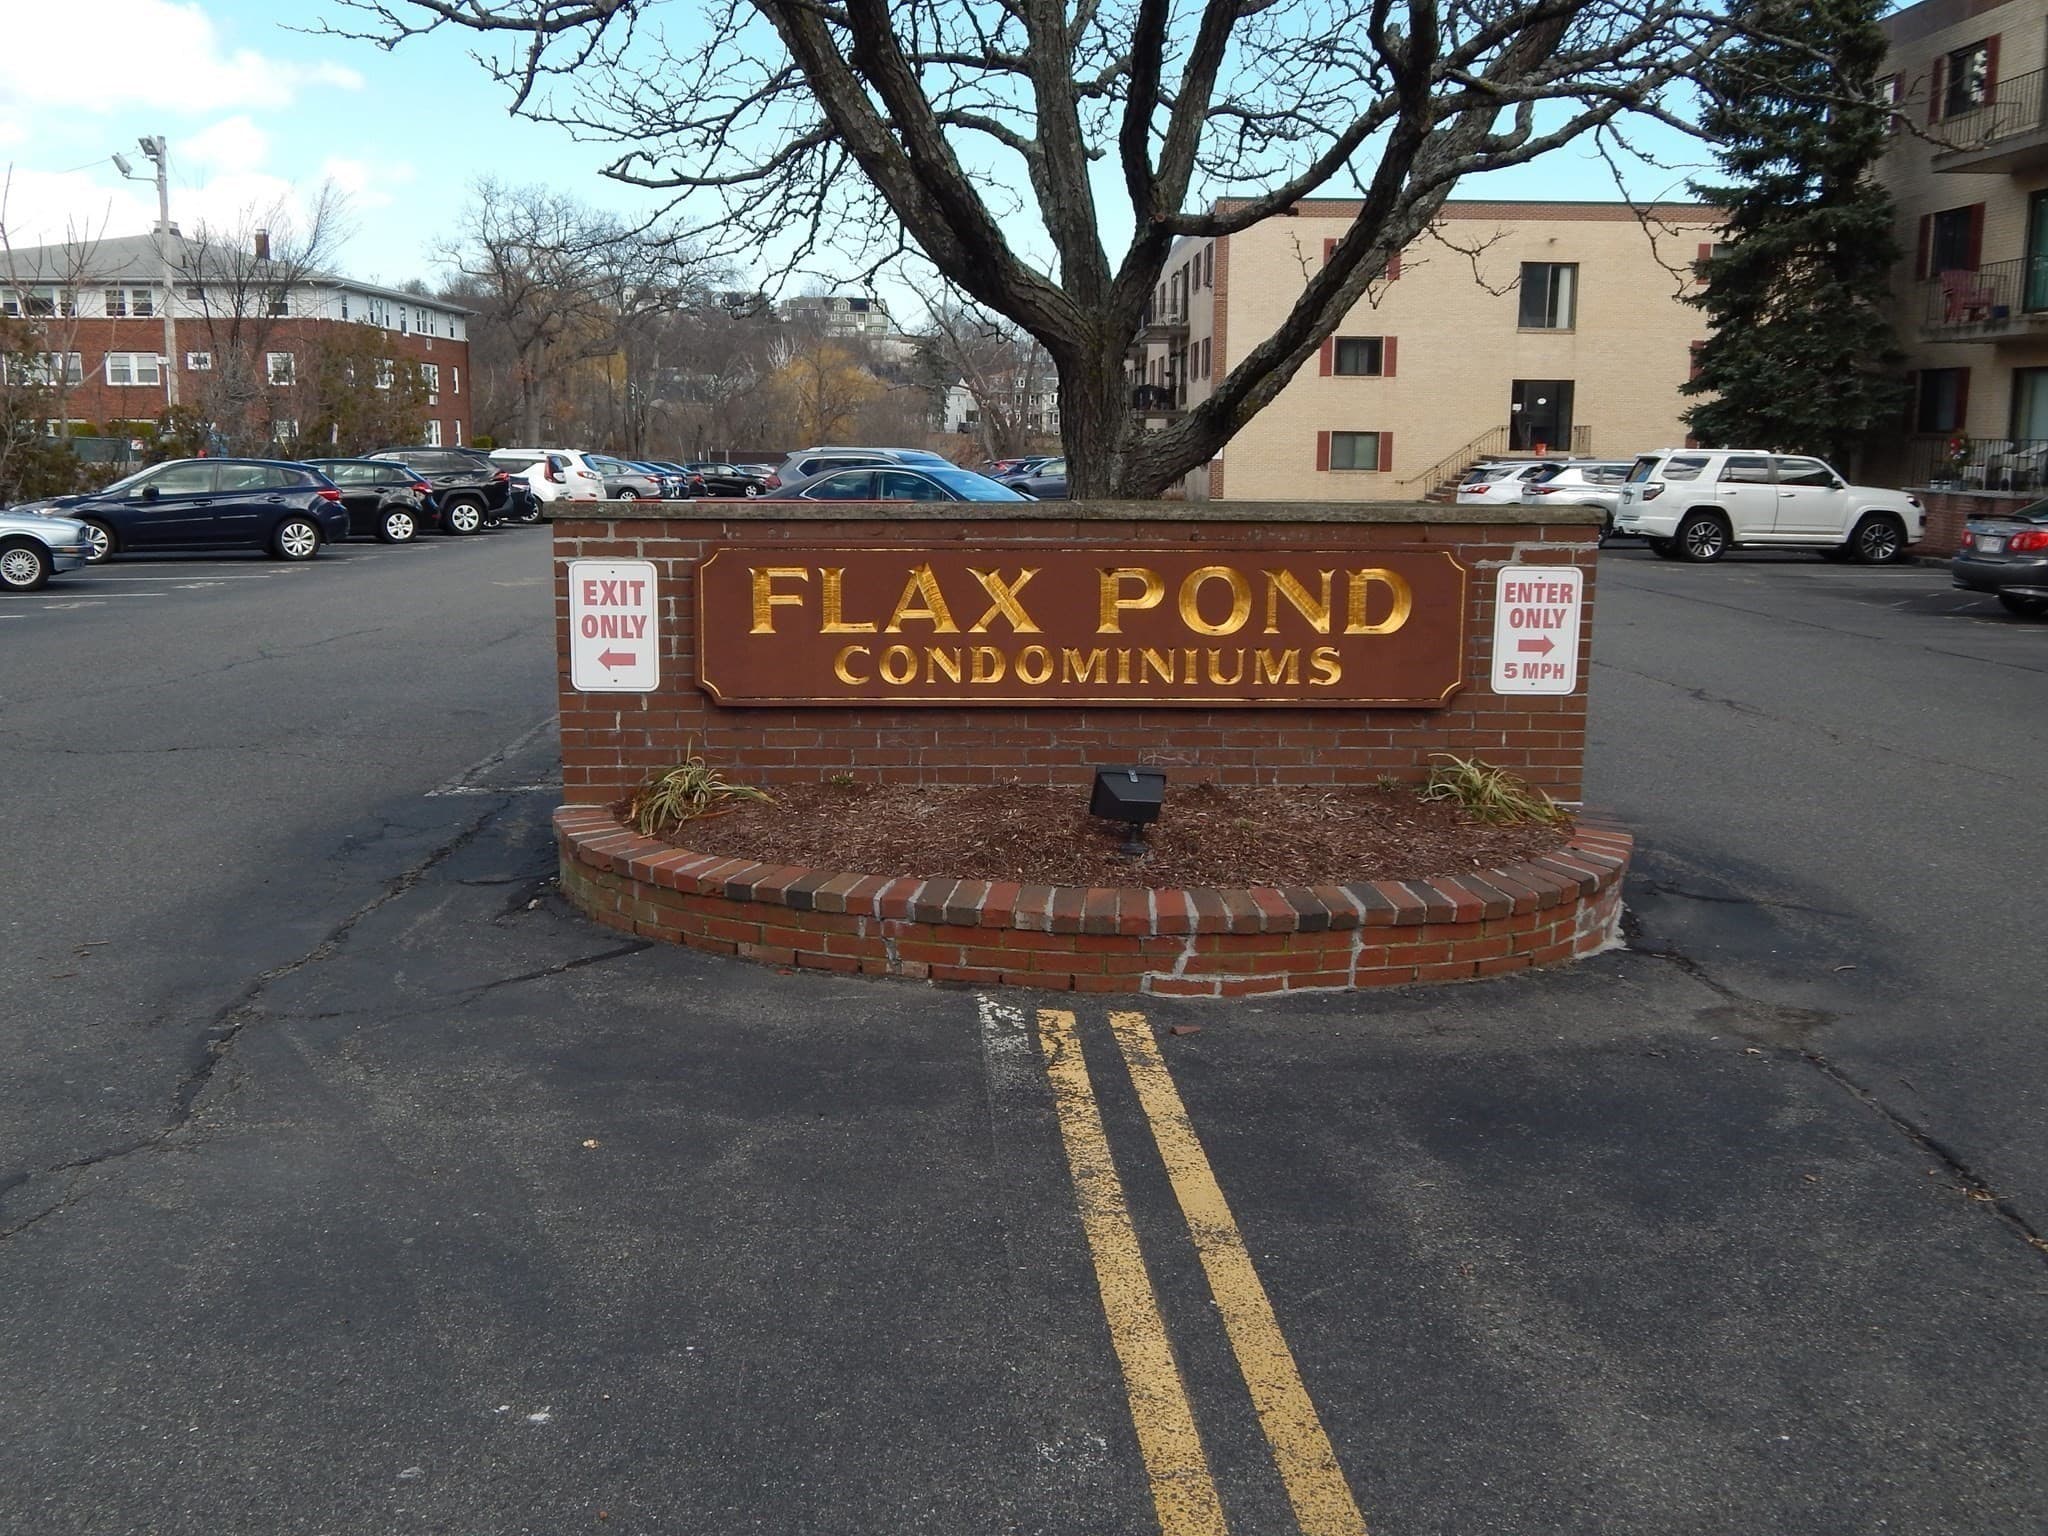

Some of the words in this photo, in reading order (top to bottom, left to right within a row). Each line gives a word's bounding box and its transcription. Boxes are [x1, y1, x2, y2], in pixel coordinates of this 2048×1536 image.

[583, 579, 645, 607] EXIT
[748, 562, 1044, 634] FLAX
[1095, 566, 1412, 636] POND
[1504, 582, 1573, 604] ENTER
[581, 614, 647, 639] ONLY
[1509, 607, 1567, 629] ONLY
[834, 645, 1342, 685] CONDOMINIUMS
[1504, 662, 1518, 679] 5
[1522, 662, 1565, 680] MPH
